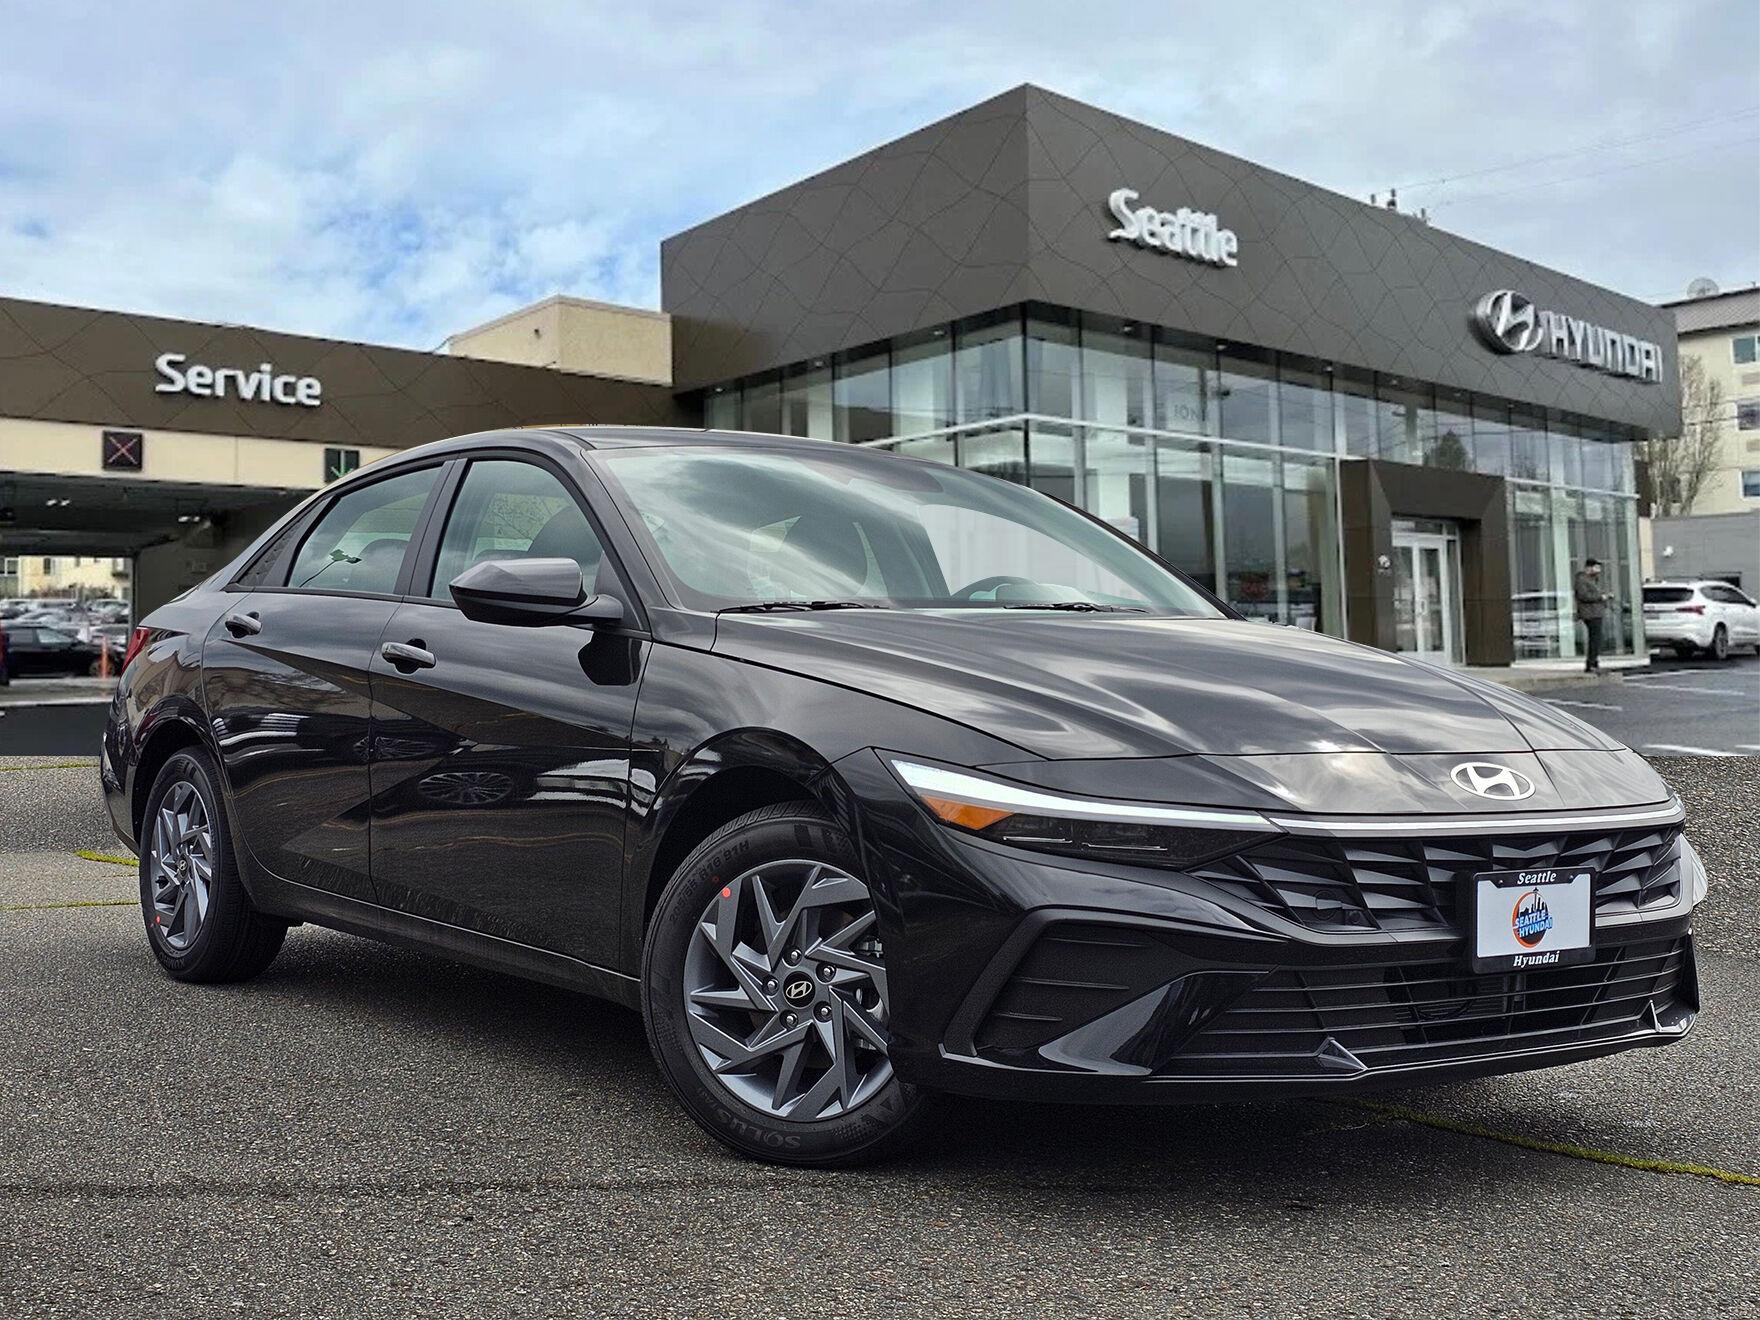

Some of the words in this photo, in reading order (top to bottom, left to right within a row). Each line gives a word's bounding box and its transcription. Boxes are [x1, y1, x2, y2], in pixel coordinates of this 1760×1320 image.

[1108, 187, 1238, 266] Seattle
[1540, 311, 1663, 382] HYUNDAI
[155, 352, 321, 406] Service
[1517, 871, 1557, 884] Seattle
[1514, 910, 1546, 929] SEATTLE
[1519, 916, 1553, 937] HYUNDAI
[1513, 951, 1560, 968] Hyundai
[719, 1108, 801, 1149] SOLUS
